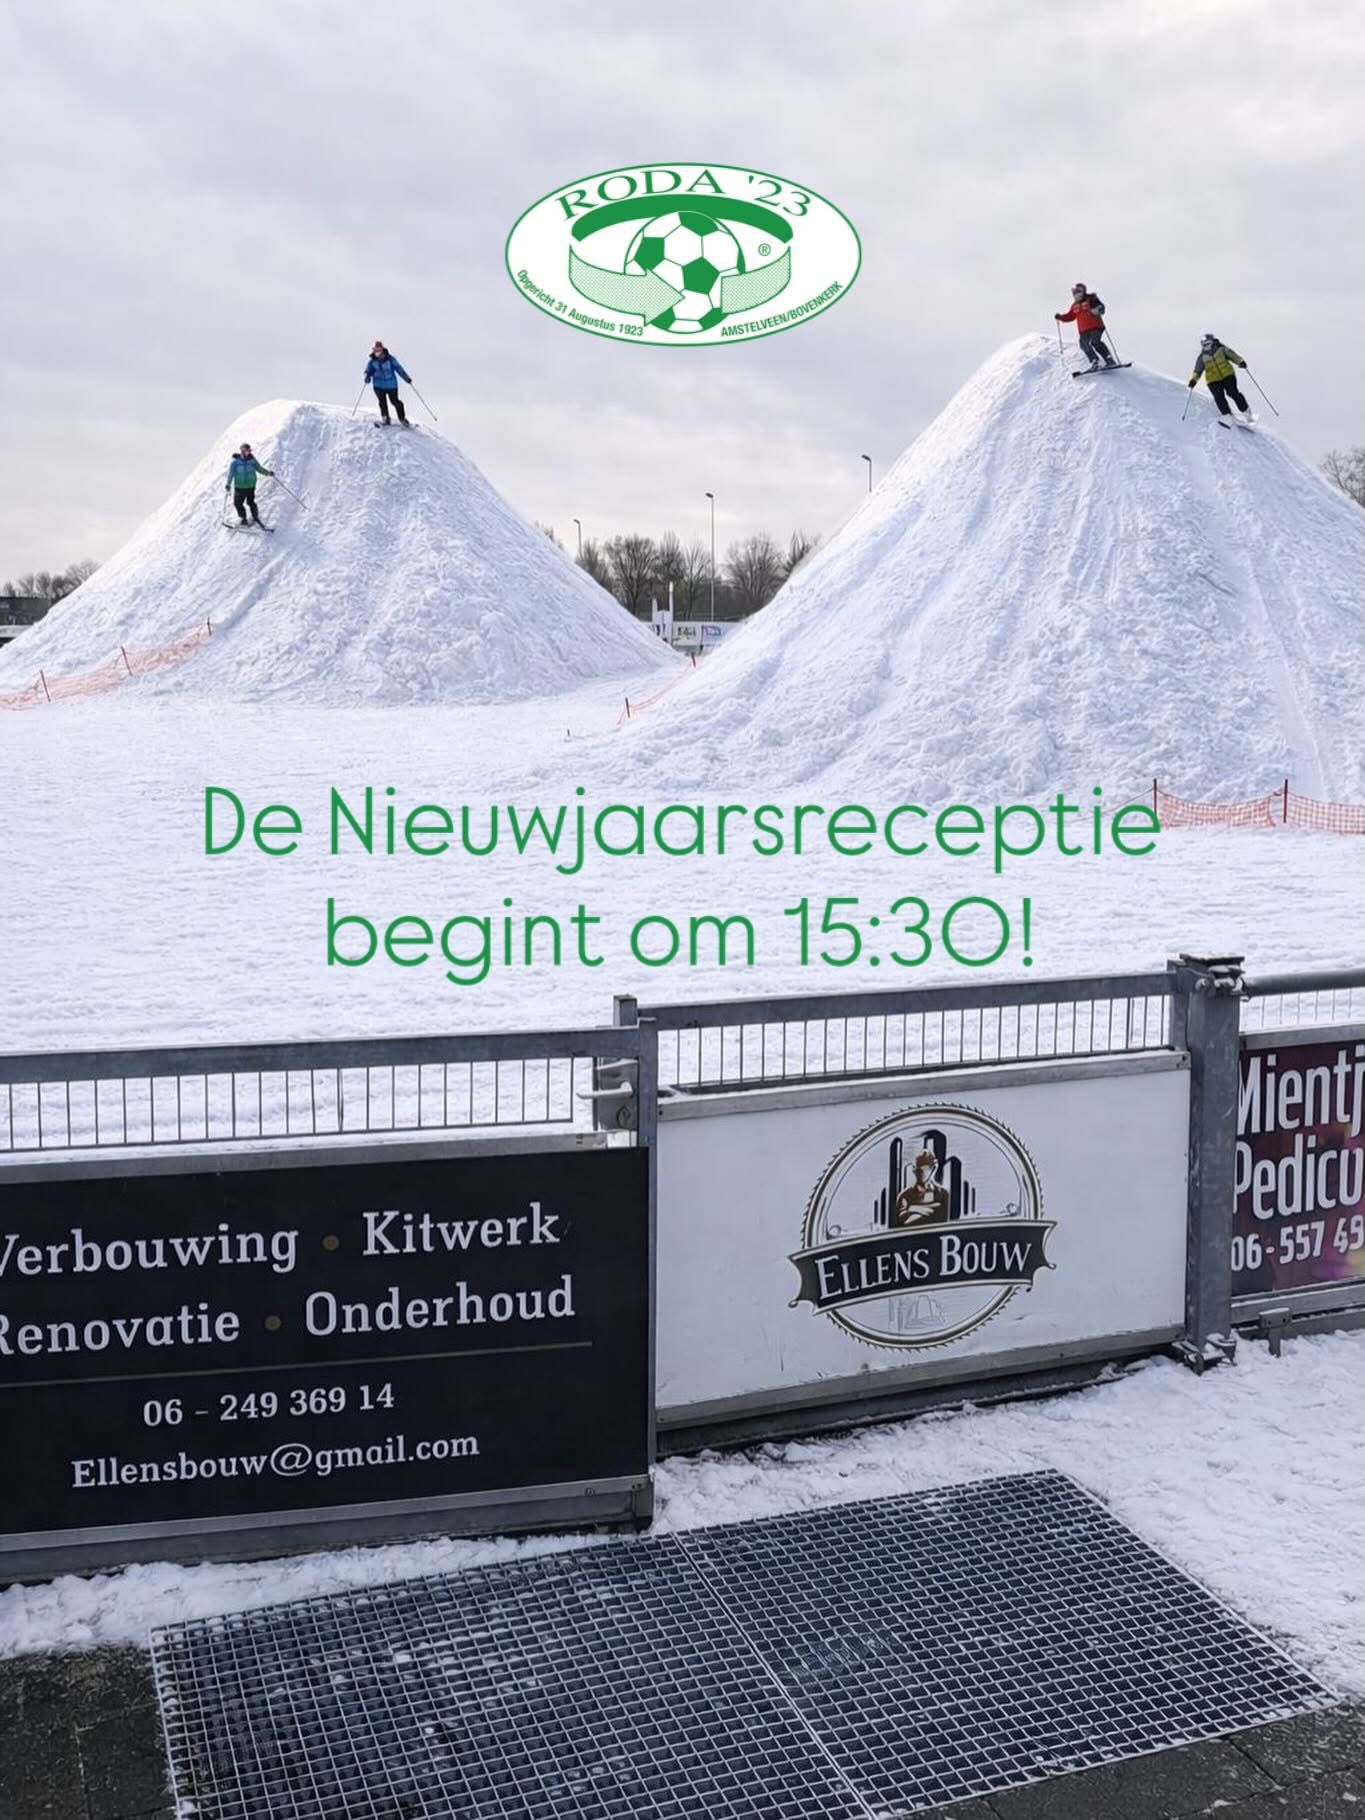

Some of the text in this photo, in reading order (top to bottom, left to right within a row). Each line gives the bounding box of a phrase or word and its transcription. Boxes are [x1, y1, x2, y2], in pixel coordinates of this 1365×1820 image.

[1232, 1133, 1364, 1220] Pedicu
[363, 1202, 560, 1256] Kitwerk
[814, 1234, 1033, 1299] ELLENS BOUW
[0, 1275, 575, 1356] Renovatie Onderhoud
[143, 1399, 183, 1426] 06
[220, 1391, 278, 1421] 249
[290, 1387, 346, 1416] 369
[359, 1383, 395, 1411] 14
[72, 1435, 480, 1488] Ellensbouw@gmail.com
